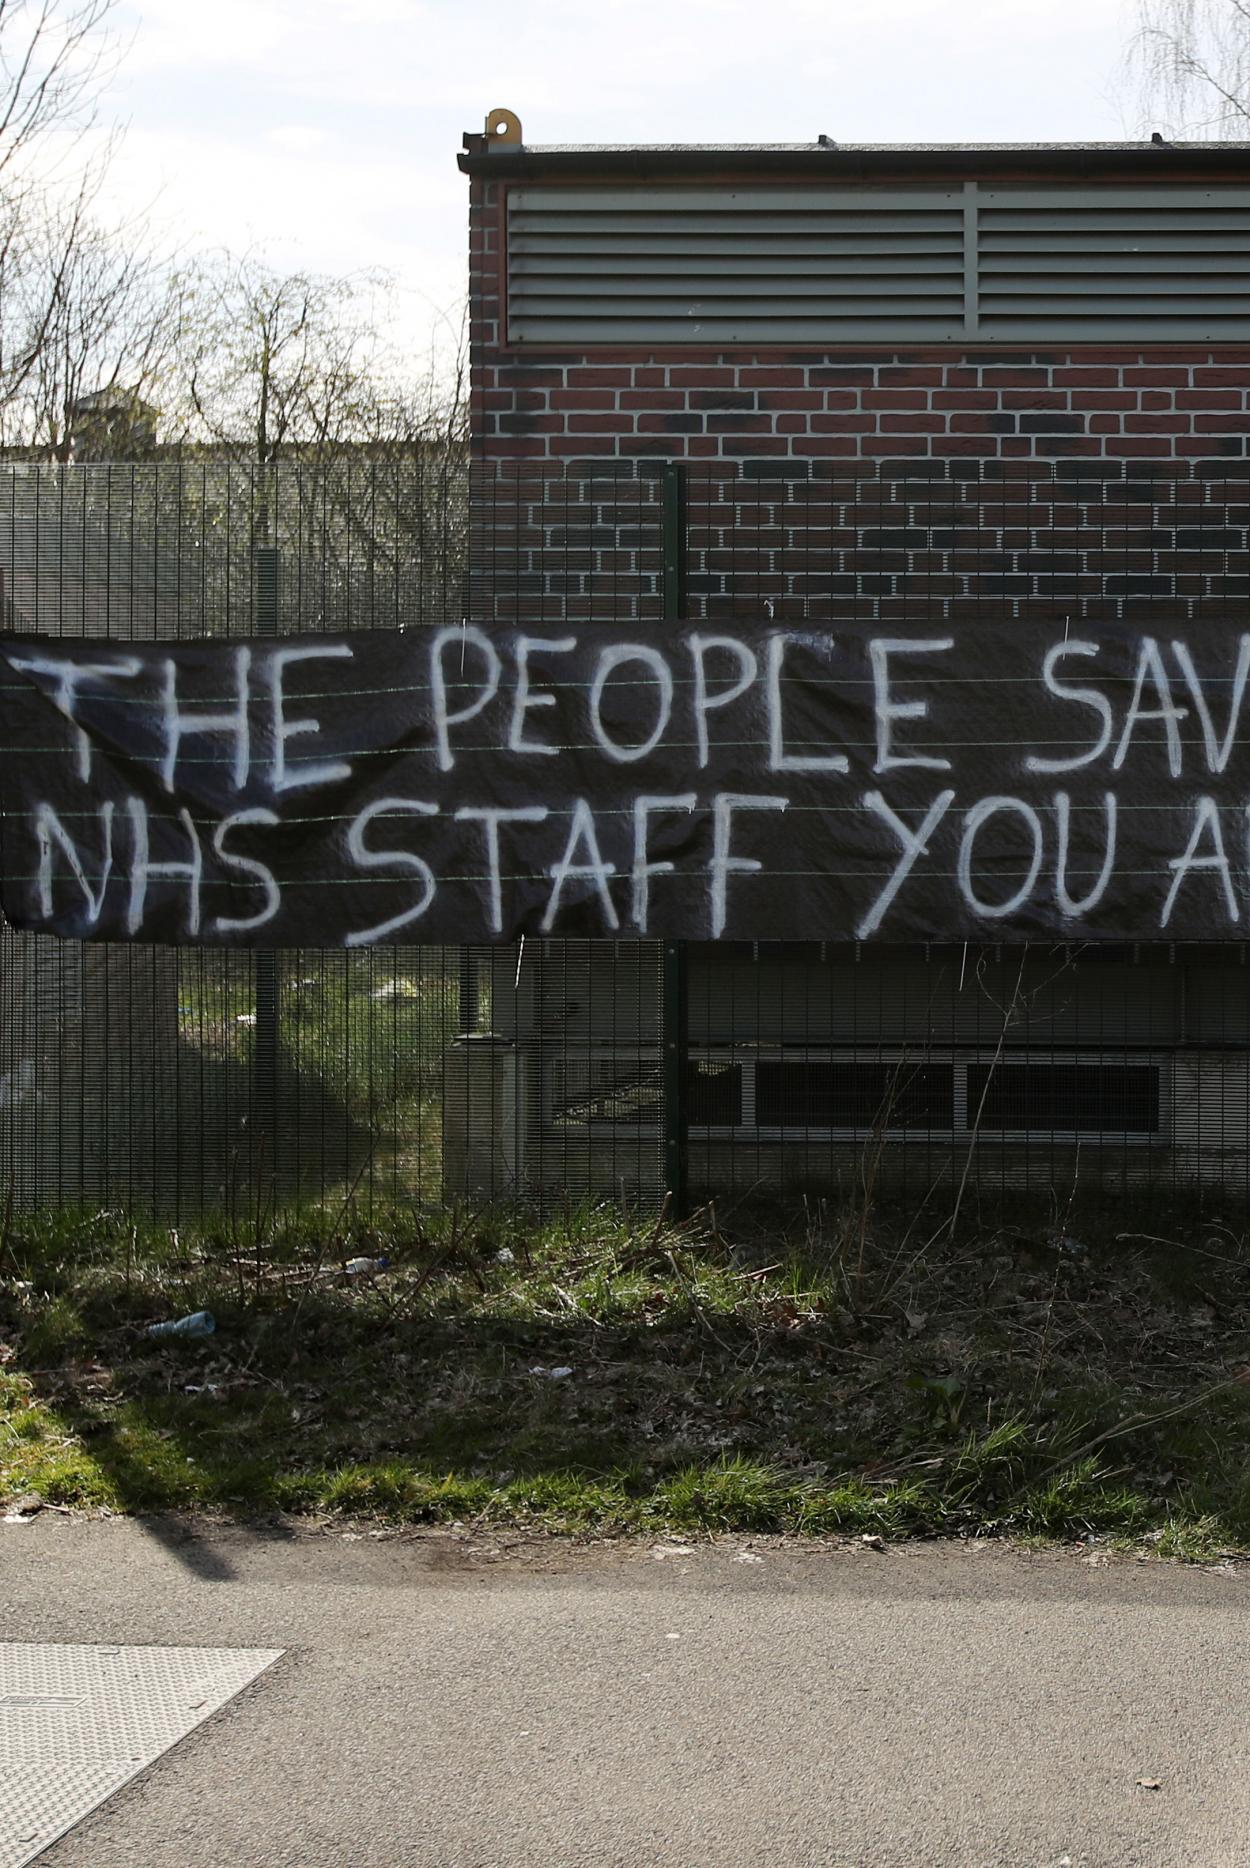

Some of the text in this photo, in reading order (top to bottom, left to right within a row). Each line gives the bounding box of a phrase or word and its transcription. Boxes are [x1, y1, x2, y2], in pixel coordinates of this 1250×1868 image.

[7, 646, 352, 792] THE
[431, 626, 953, 773] PEOPLE
[35, 798, 280, 935] NHS
[346, 794, 788, 946] STAFF
[857, 790, 1116, 940] YOU
